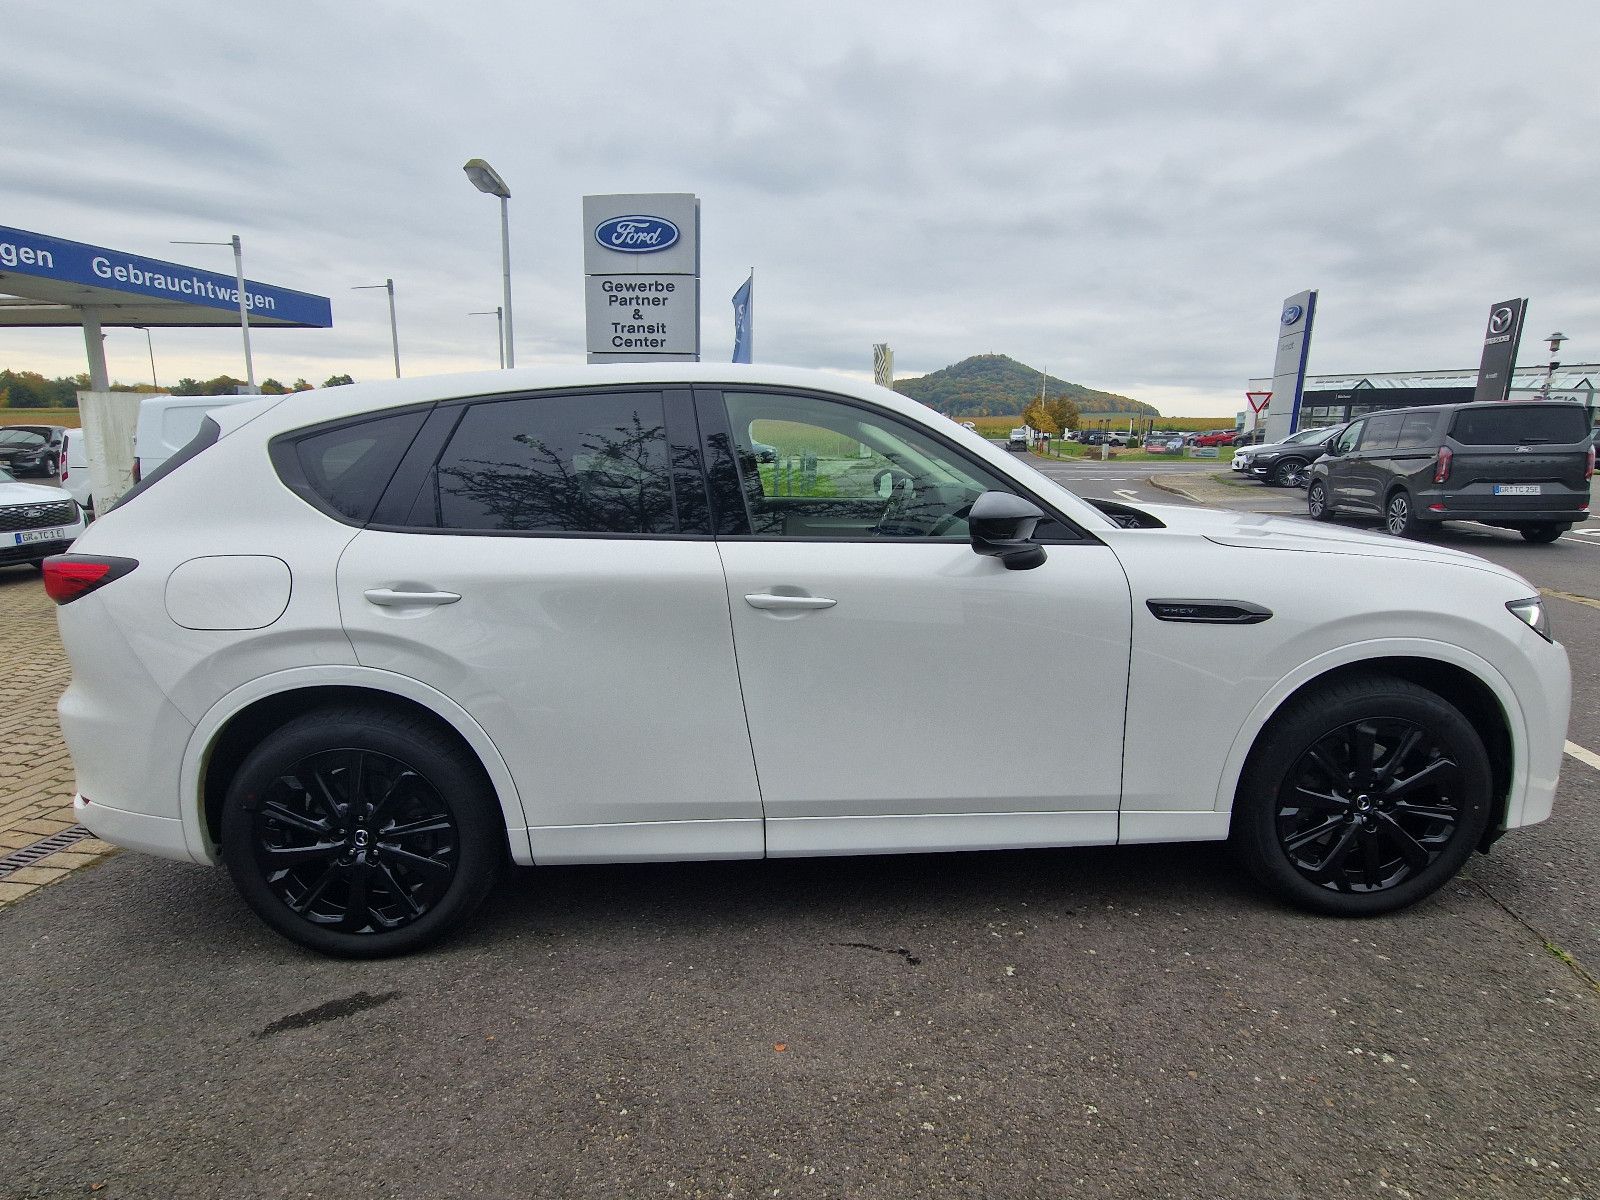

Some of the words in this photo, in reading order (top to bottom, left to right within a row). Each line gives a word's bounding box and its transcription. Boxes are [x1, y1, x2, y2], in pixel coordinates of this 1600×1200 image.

[612, 221, 662, 245] Ford
[92, 256, 275, 310] Gebrauchtwagen
[601, 280, 675, 293] Gewerbe
[608, 294, 669, 306] Partner
[632, 309, 644, 320] &
[611, 322, 667, 334] Transit
[611, 335, 666, 348] Center
